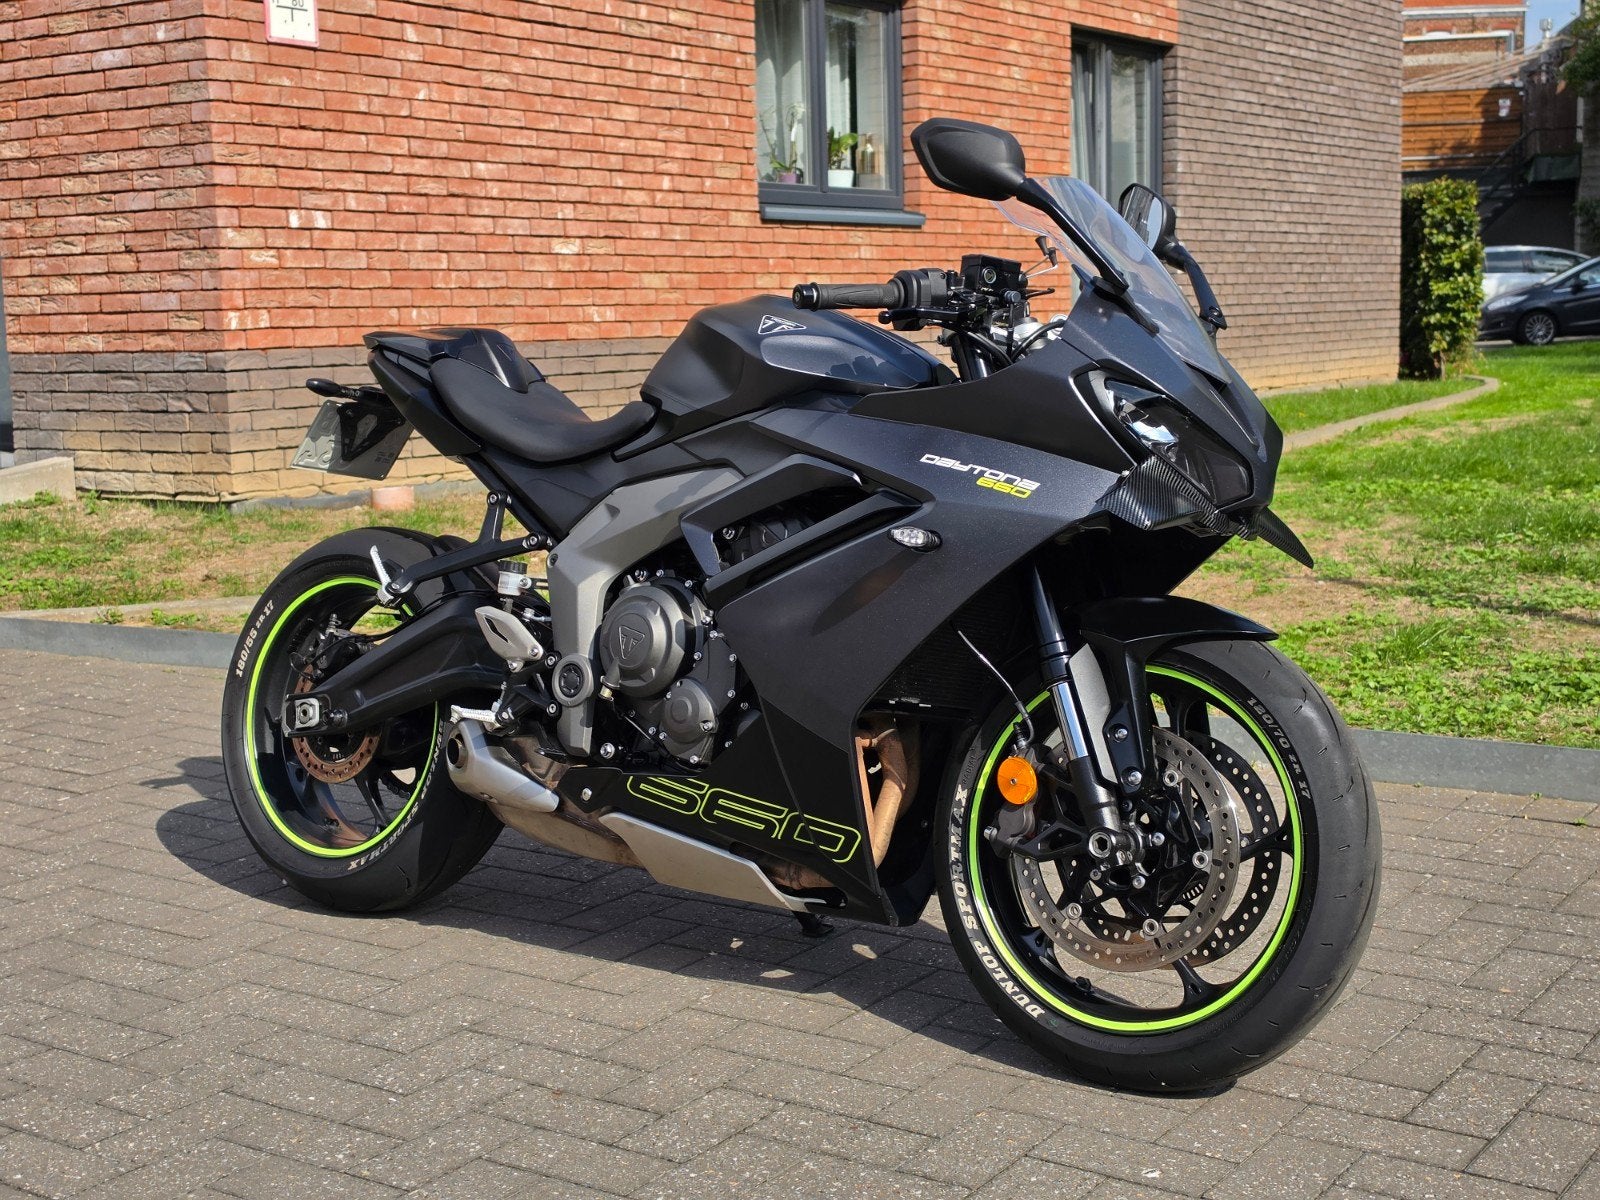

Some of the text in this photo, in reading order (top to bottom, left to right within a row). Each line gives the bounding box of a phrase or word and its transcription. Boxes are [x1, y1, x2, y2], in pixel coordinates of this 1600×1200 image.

[976, 476, 1032, 498] 660
[235, 627, 258, 678] 180/55
[263, 599, 274, 616] 17
[1246, 697, 1291, 749] 120/70
[1298, 780, 1311, 800] 17
[347, 801, 419, 870] SPORTMAX
[626, 775, 862, 863] 660
[948, 784, 1046, 1019] DUNLOP SPORTMAX
